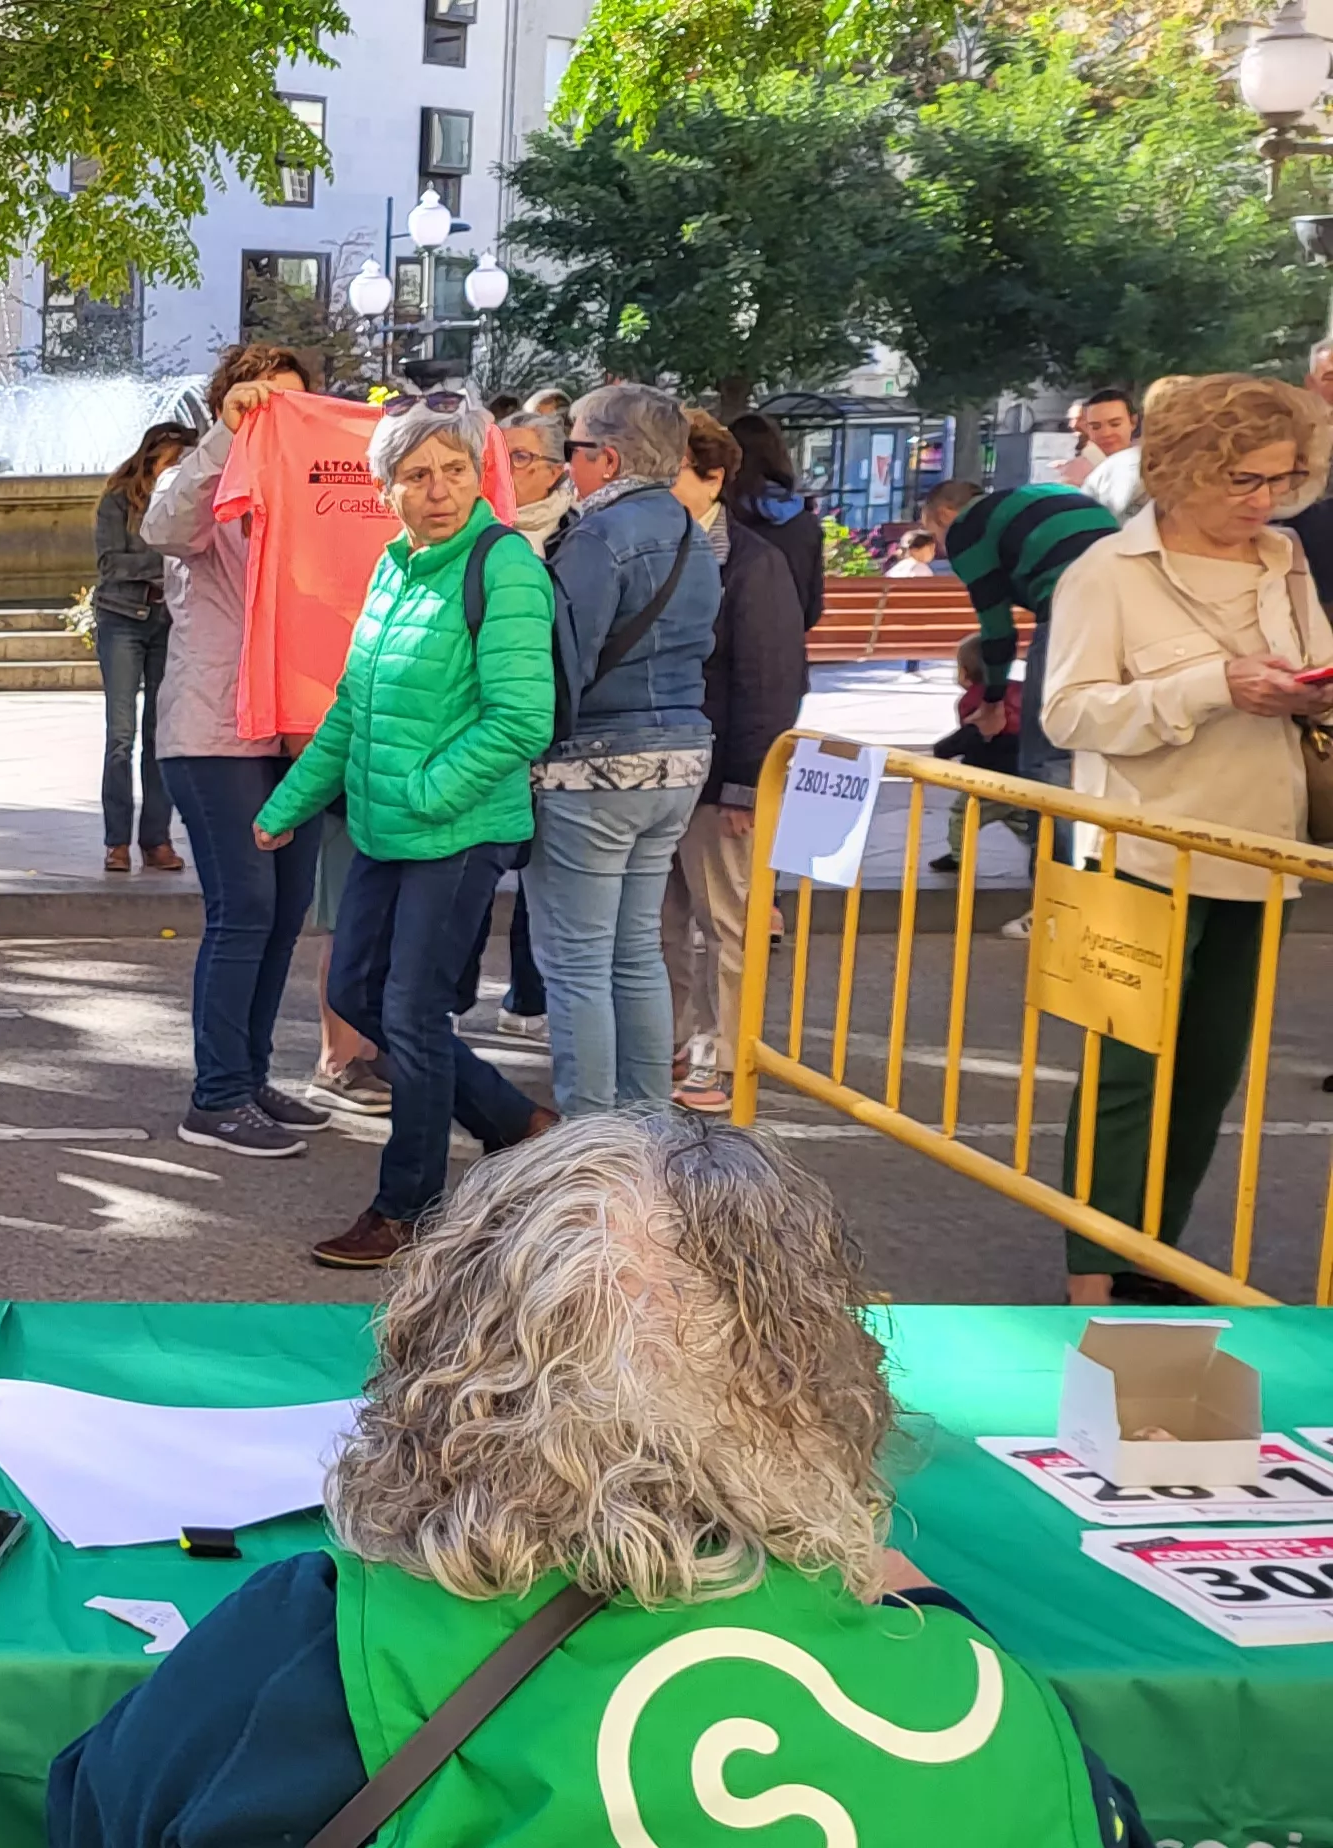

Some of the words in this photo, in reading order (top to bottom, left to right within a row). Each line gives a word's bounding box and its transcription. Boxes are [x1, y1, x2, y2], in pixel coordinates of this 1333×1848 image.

[795, 767, 870, 802] 2801-3200
[1081, 925, 1163, 970] Ayuntamiento
[1150, 1548, 1270, 1561] CONTRA
[1266, 1548, 1305, 1559] EL
[1173, 1563, 1333, 1602] 30
